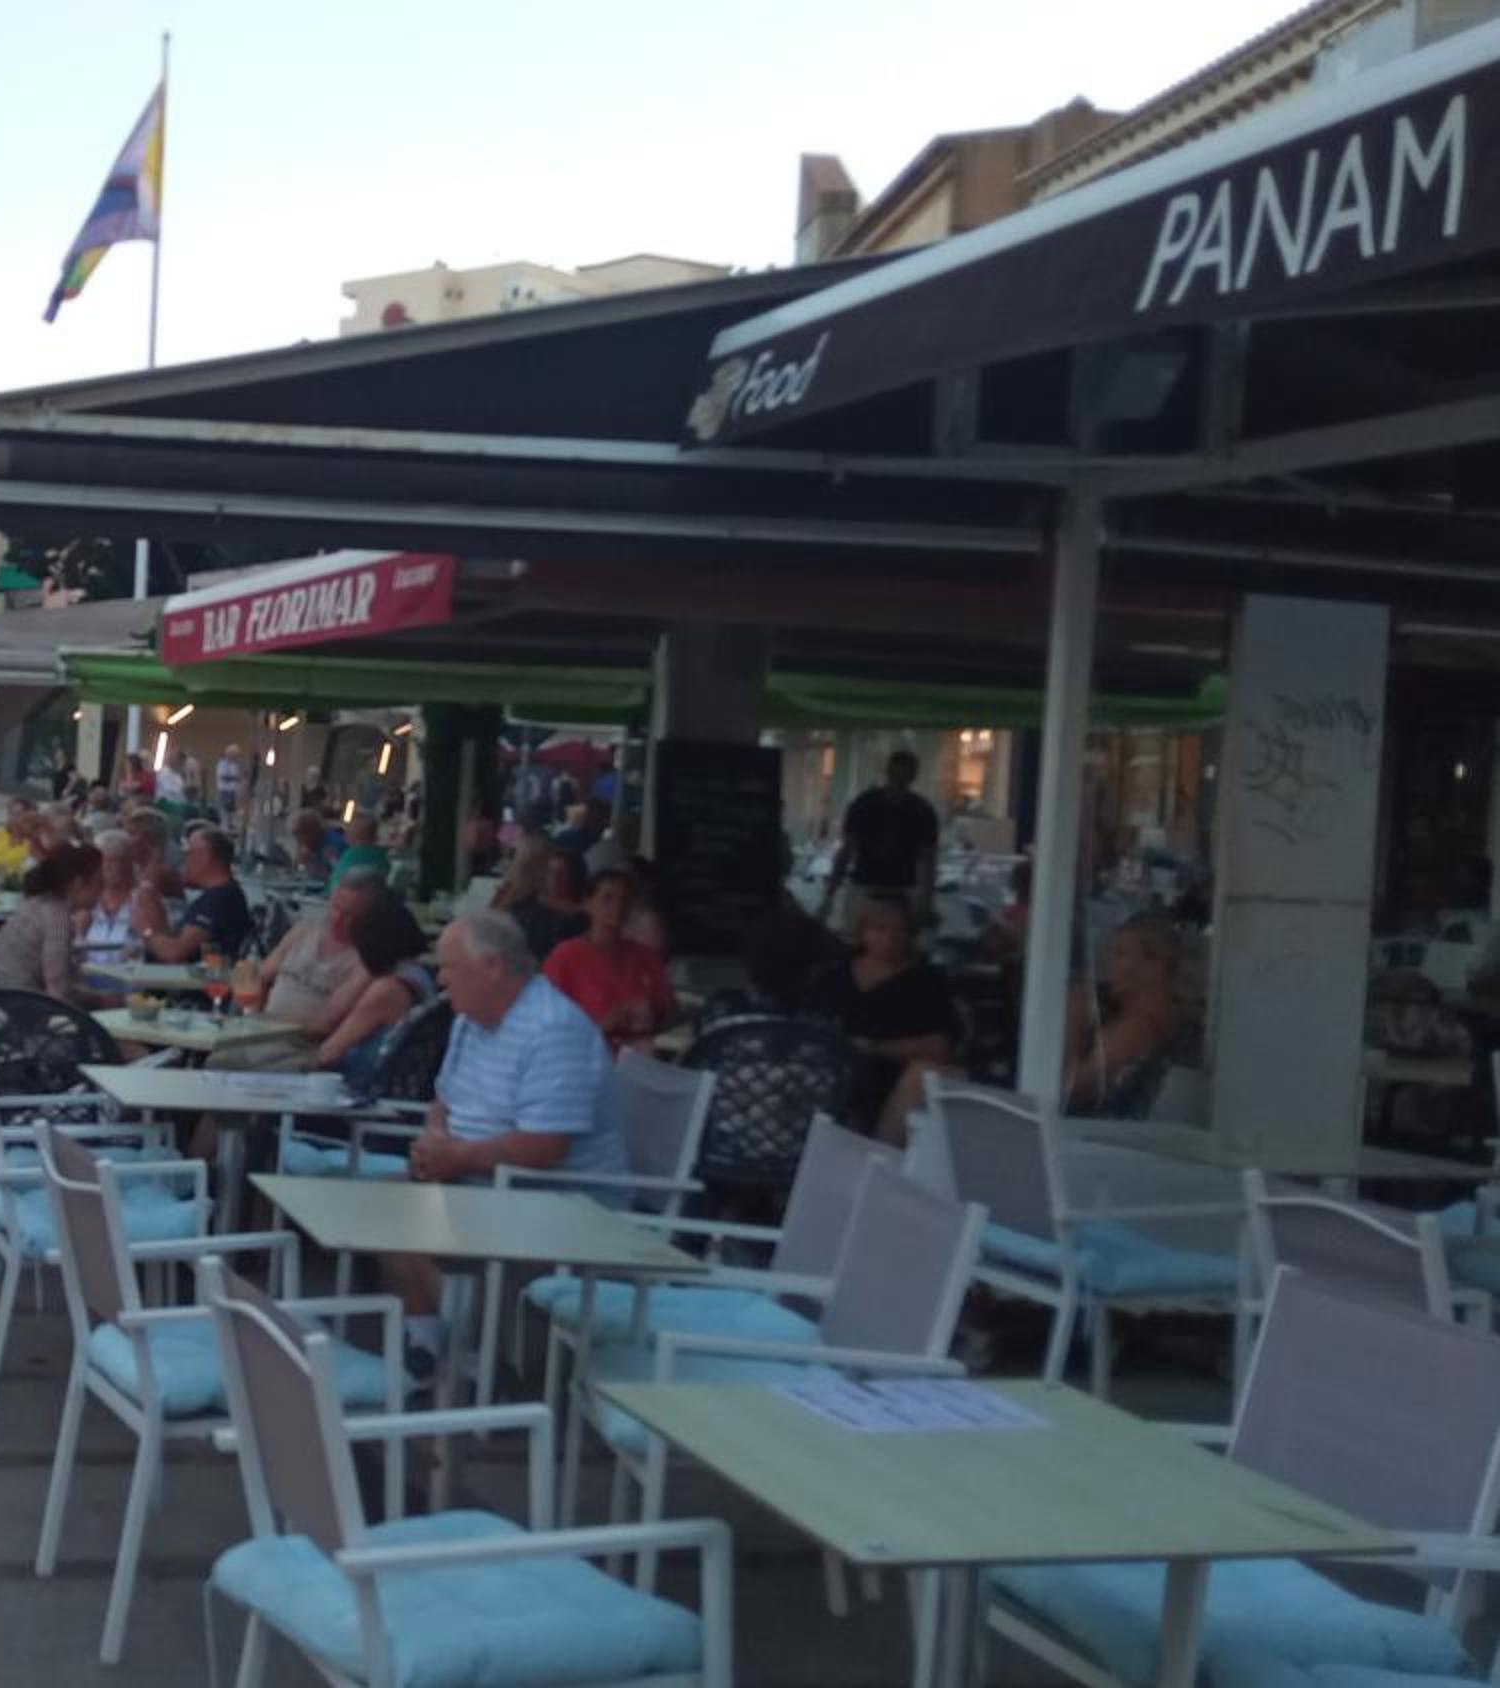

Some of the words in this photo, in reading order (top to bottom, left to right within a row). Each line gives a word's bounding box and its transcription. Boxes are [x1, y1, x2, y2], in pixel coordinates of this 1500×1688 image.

[1133, 93, 1467, 312] PANAM
[202, 604, 243, 653] BAR
[245, 571, 377, 644] FLORIMAR
